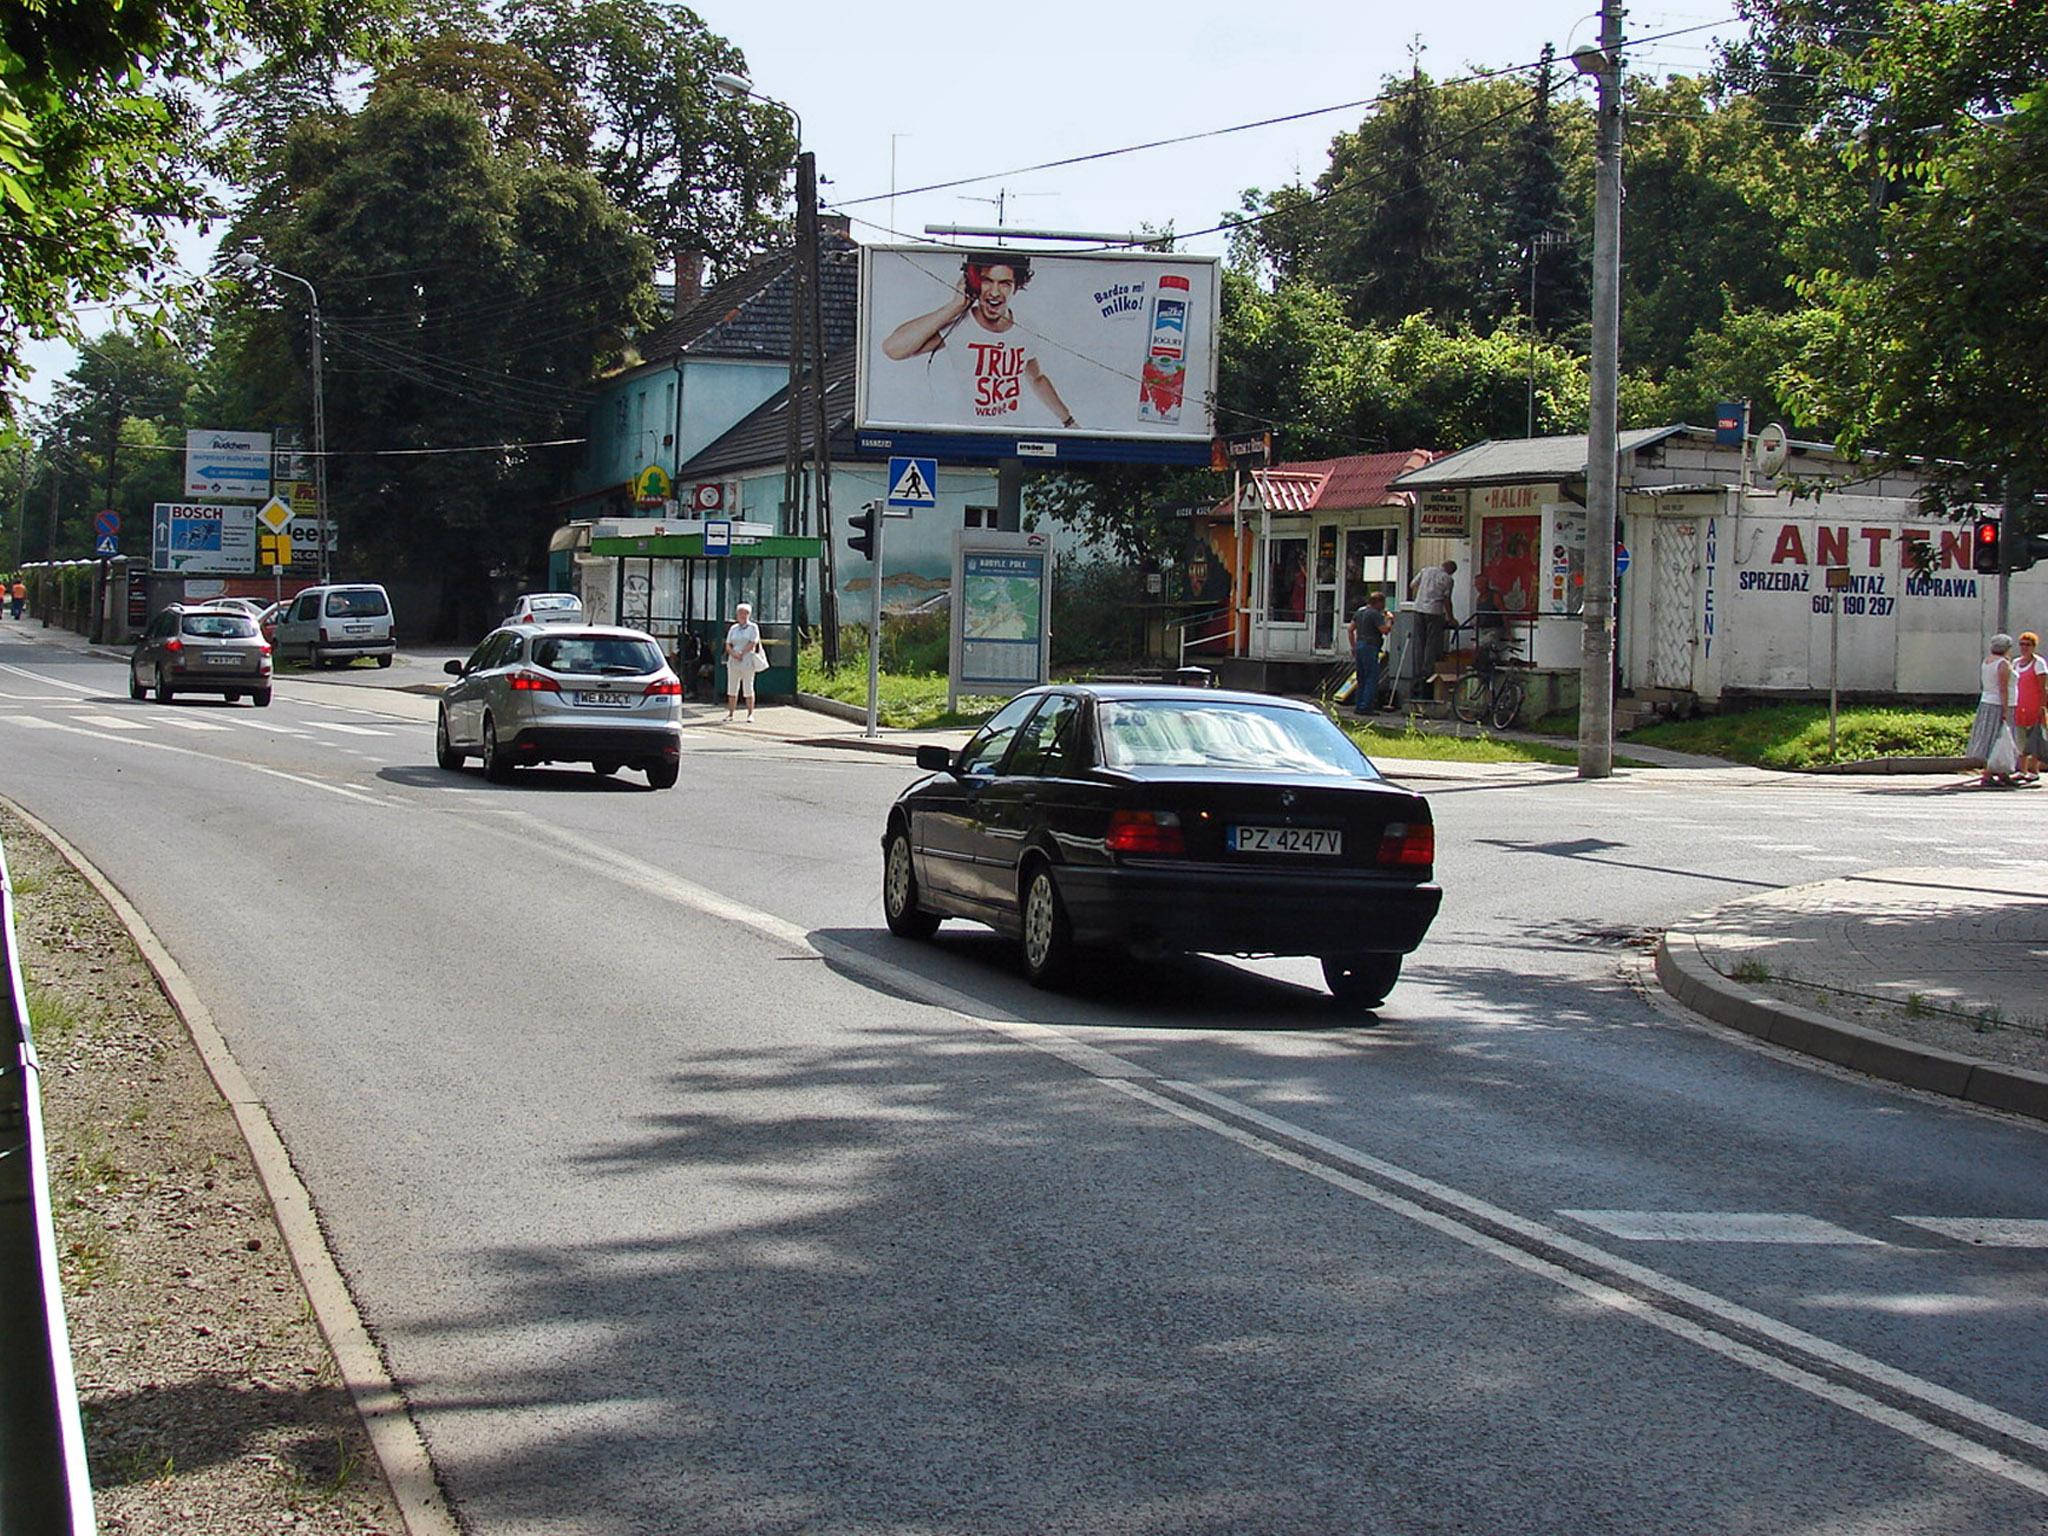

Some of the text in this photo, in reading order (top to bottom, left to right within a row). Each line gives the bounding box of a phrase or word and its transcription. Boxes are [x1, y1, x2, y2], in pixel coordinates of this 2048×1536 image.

[1094, 281, 1145, 304] Bardzo mi
[1101, 296, 1144, 319] milko!
[967, 341, 1025, 378] TRUE
[172, 506, 223, 519] BOSCH
[1703, 517, 1717, 660] ANTENY
[1740, 570, 1809, 592] SPRZEDAŻ
[1906, 576, 1977, 598] NAPRAWA
[1843, 596, 1865, 615] 190
[1869, 597, 1895, 616] 297
[1239, 828, 1338, 852] PZ 4247V
